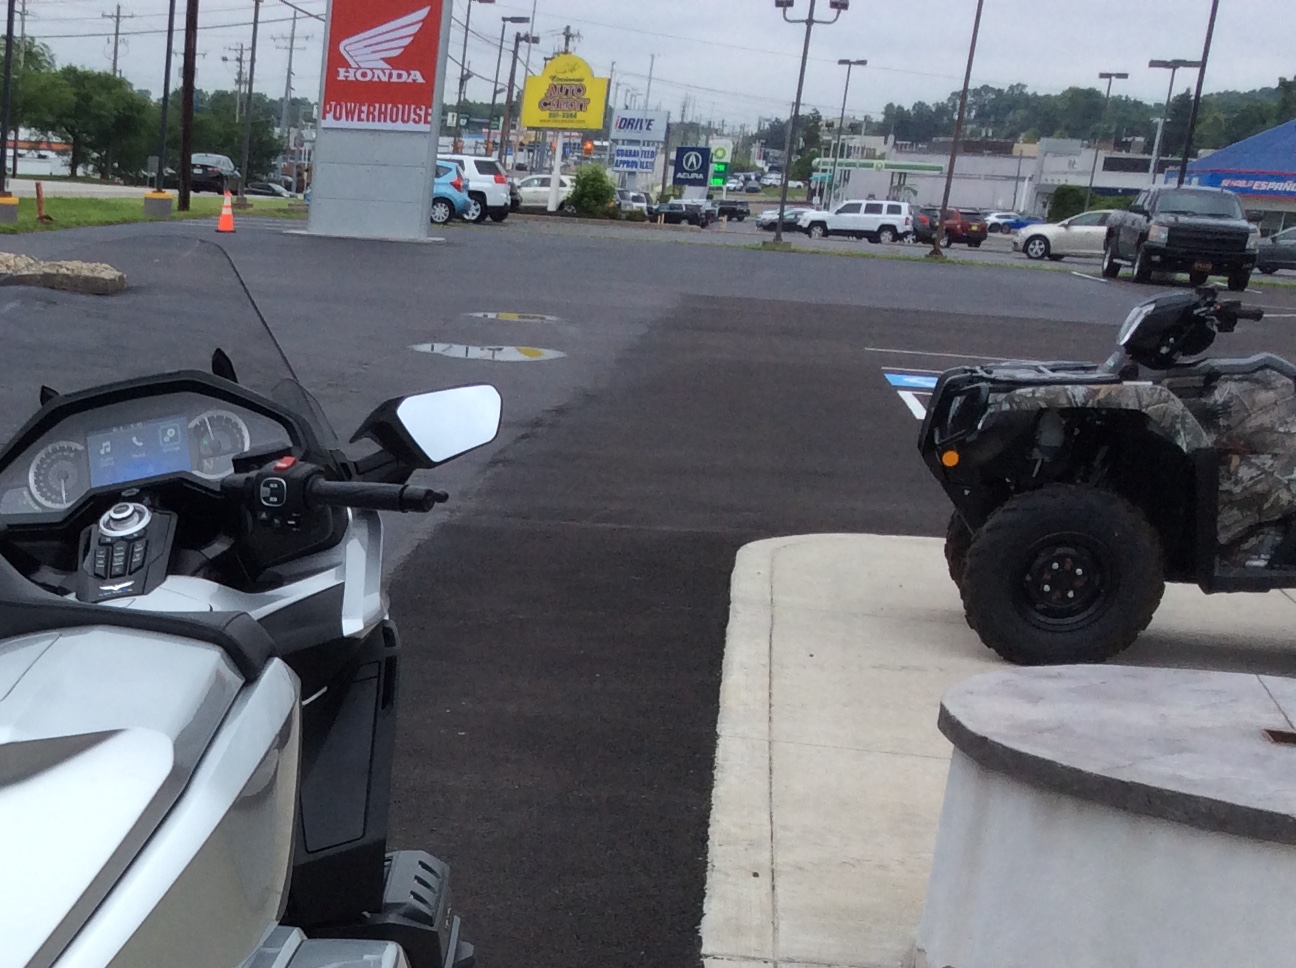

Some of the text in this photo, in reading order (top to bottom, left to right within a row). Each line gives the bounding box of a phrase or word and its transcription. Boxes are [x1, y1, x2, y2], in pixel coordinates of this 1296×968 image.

[337, 67, 426, 84] HONDA
[546, 83, 586, 99] AUTO
[321, 101, 433, 125] POWERHOUSE
[614, 116, 655, 131] iDRIVE
[676, 172, 704, 180] ACURA
